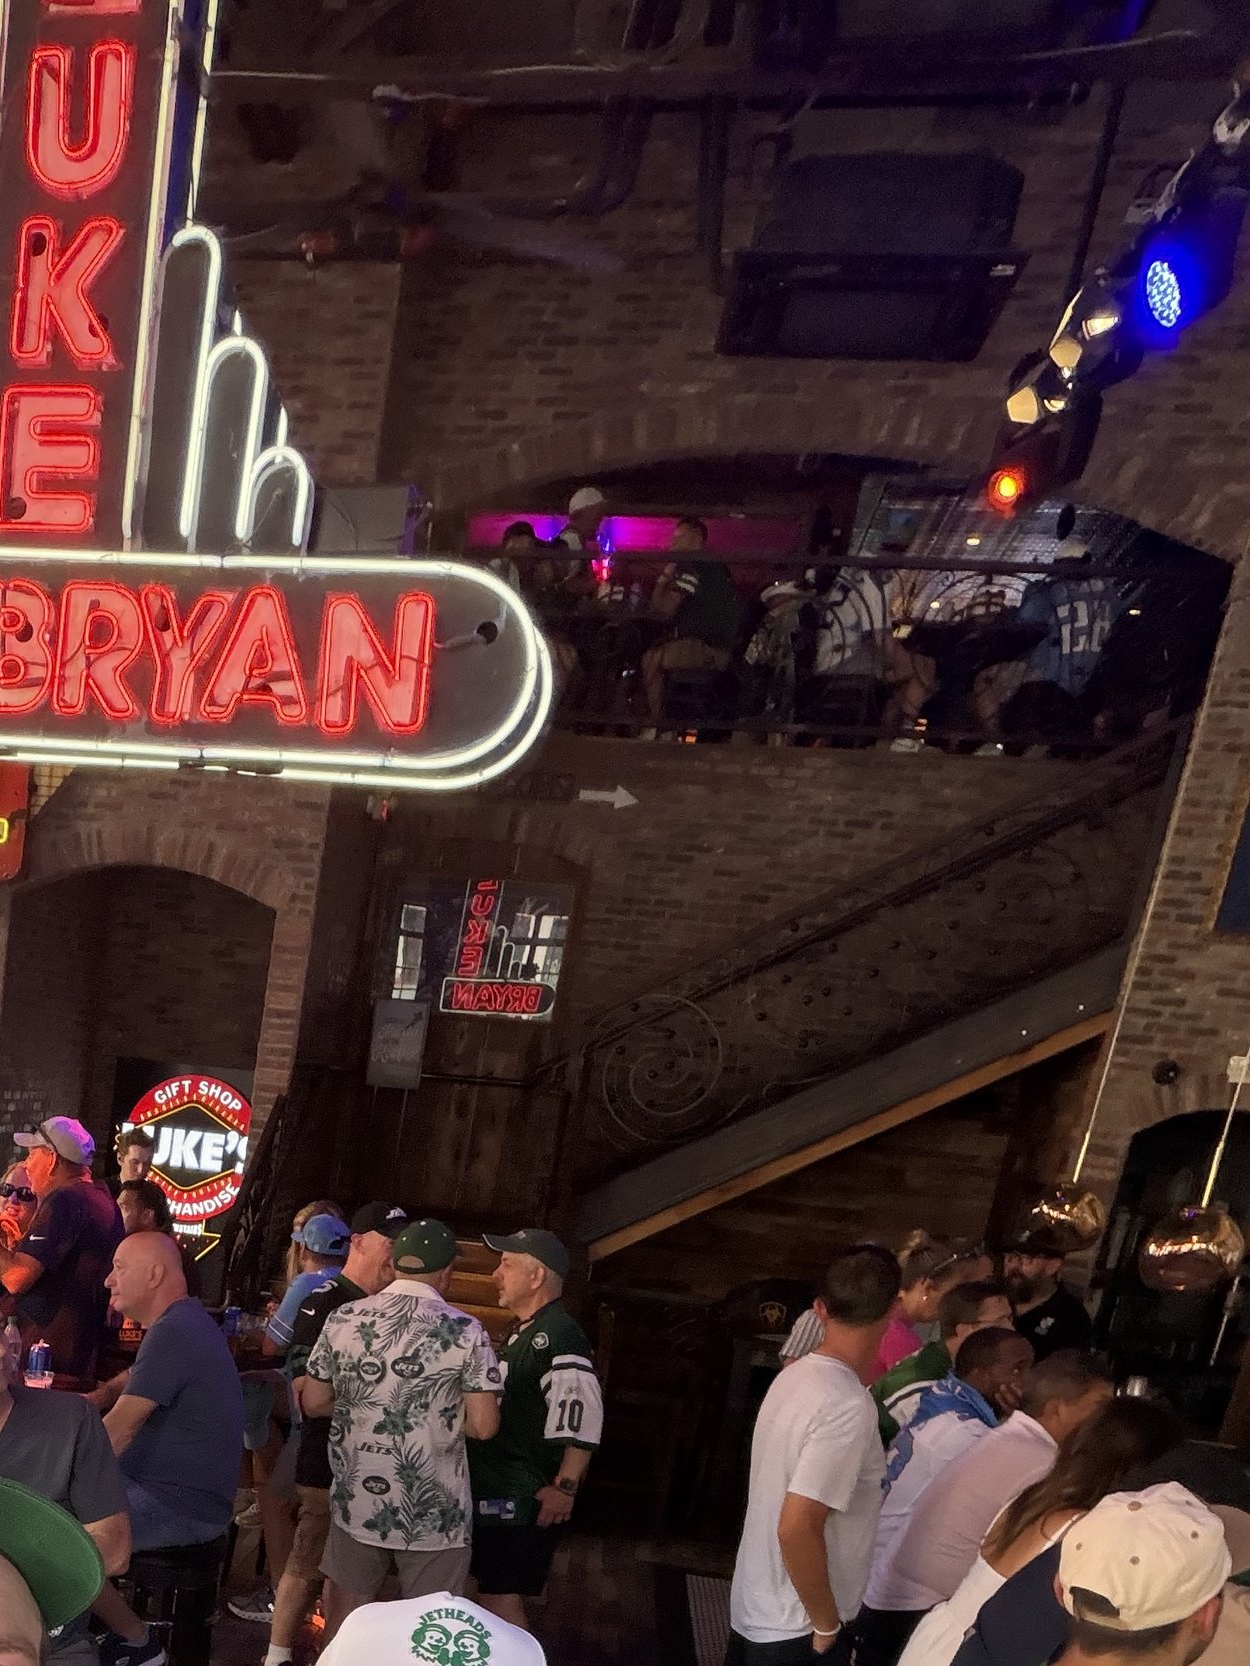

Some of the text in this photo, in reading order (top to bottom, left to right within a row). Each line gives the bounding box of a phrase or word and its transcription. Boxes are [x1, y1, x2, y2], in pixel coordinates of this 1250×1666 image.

[154, 1079, 243, 1112] GIFT SHOP
[167, 1183, 240, 1217] HANDISE
[555, 1399, 583, 1433] 10
[357, 1441, 393, 1456] JETS
[418, 1607, 492, 1640] JETHEADS
